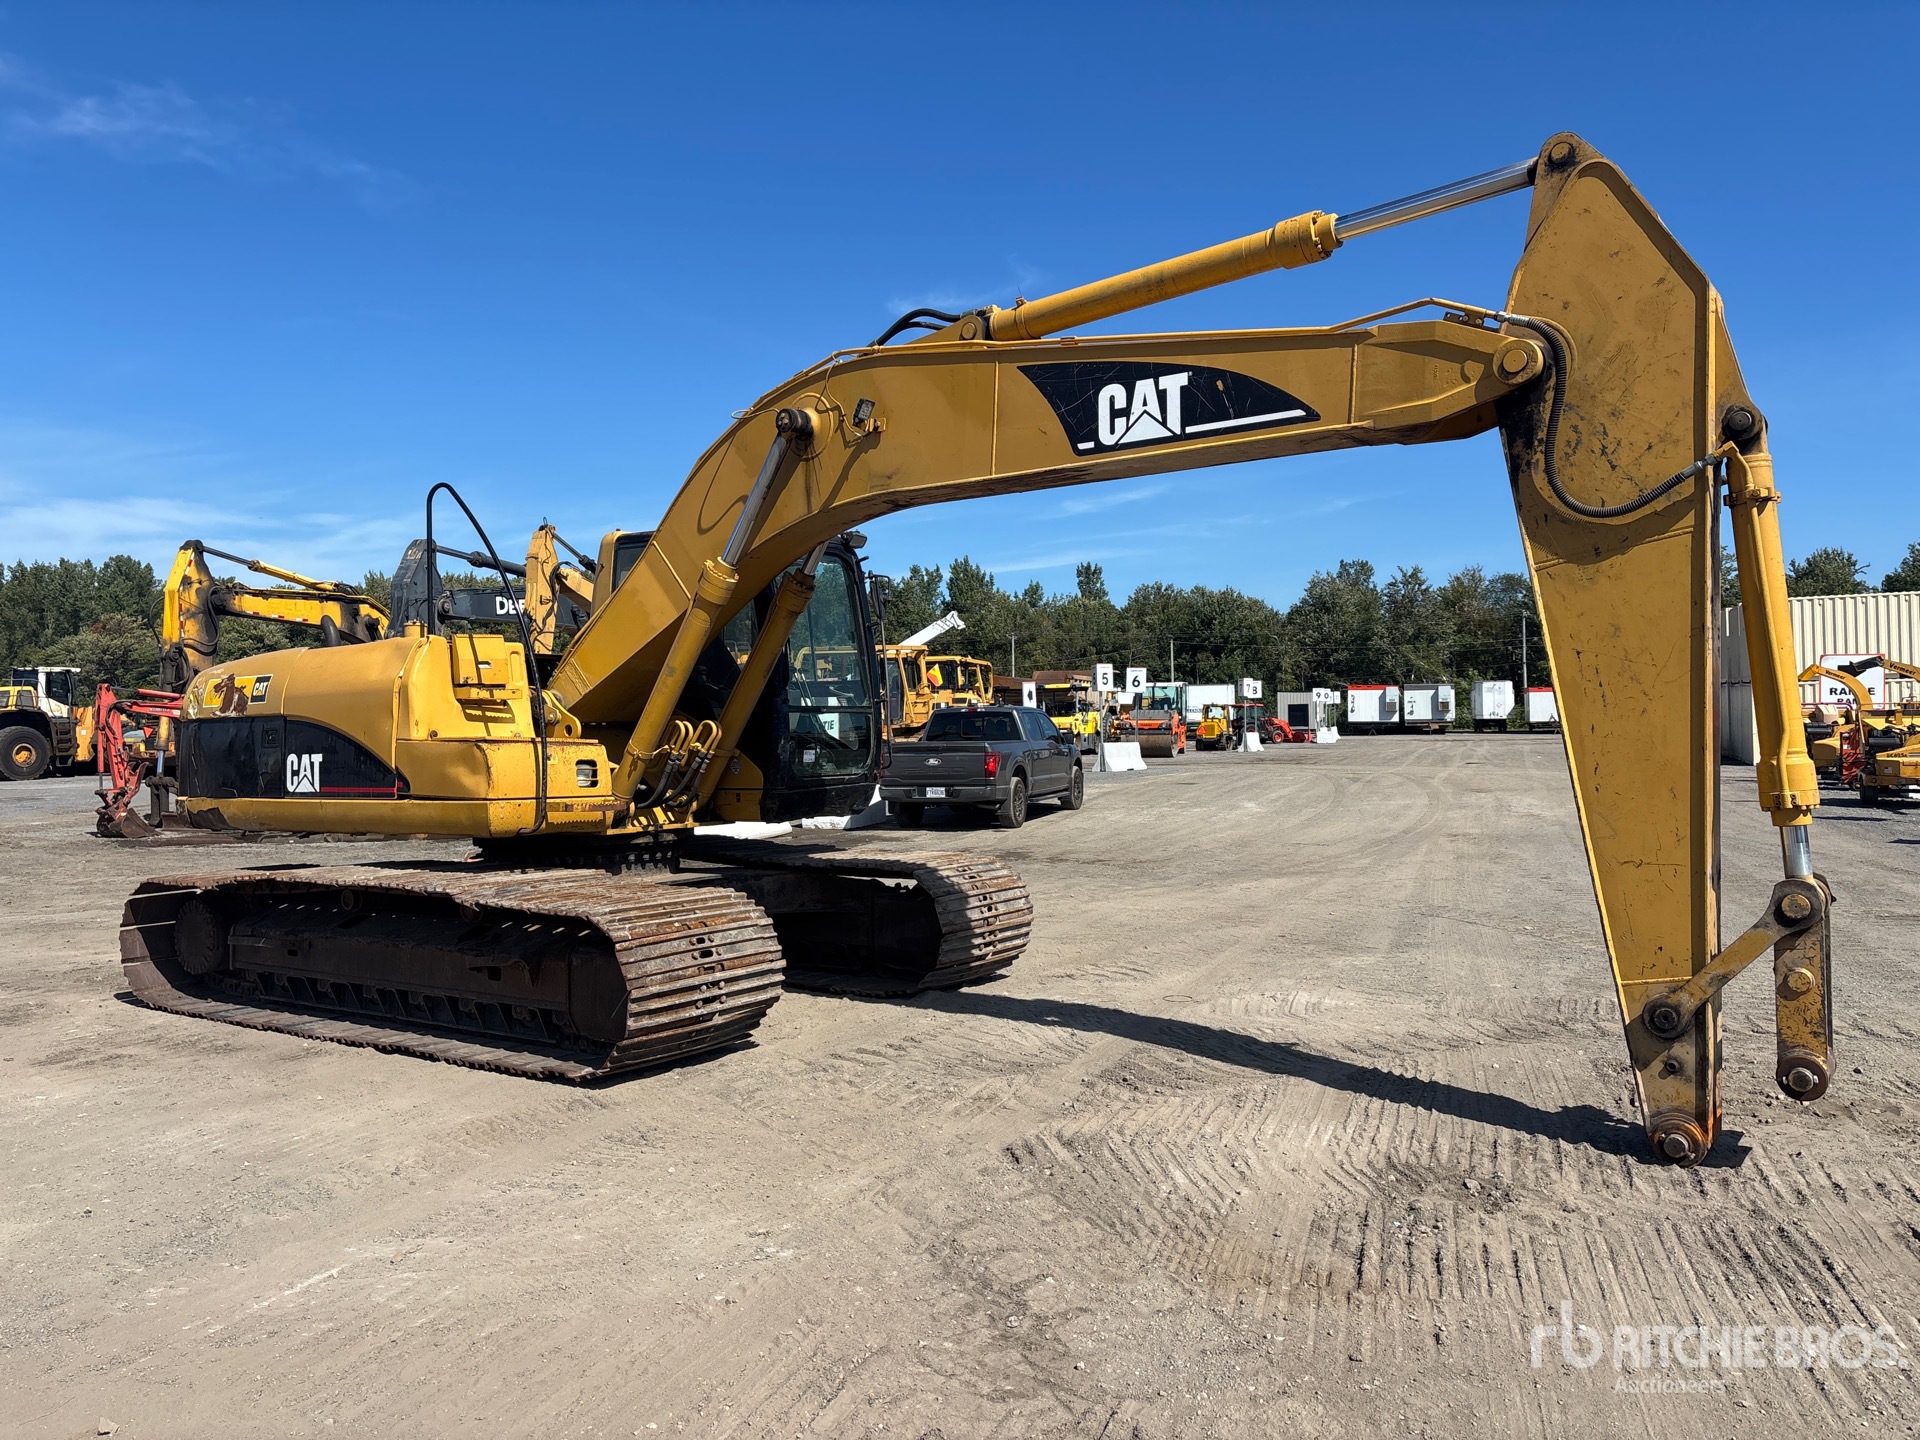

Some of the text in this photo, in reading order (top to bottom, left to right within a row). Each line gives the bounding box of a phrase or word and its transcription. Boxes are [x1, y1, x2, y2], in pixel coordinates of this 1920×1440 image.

[1098, 371, 1189, 446] CAT
[1825, 669, 1846, 680] Vermeer
[1888, 662, 1917, 676] Vermeer
[1102, 672, 1109, 686] 5
[1132, 675, 1141, 688] 6
[252, 681, 269, 697] CAT
[1315, 691, 1321, 700] 9
[286, 753, 323, 793] CAT
